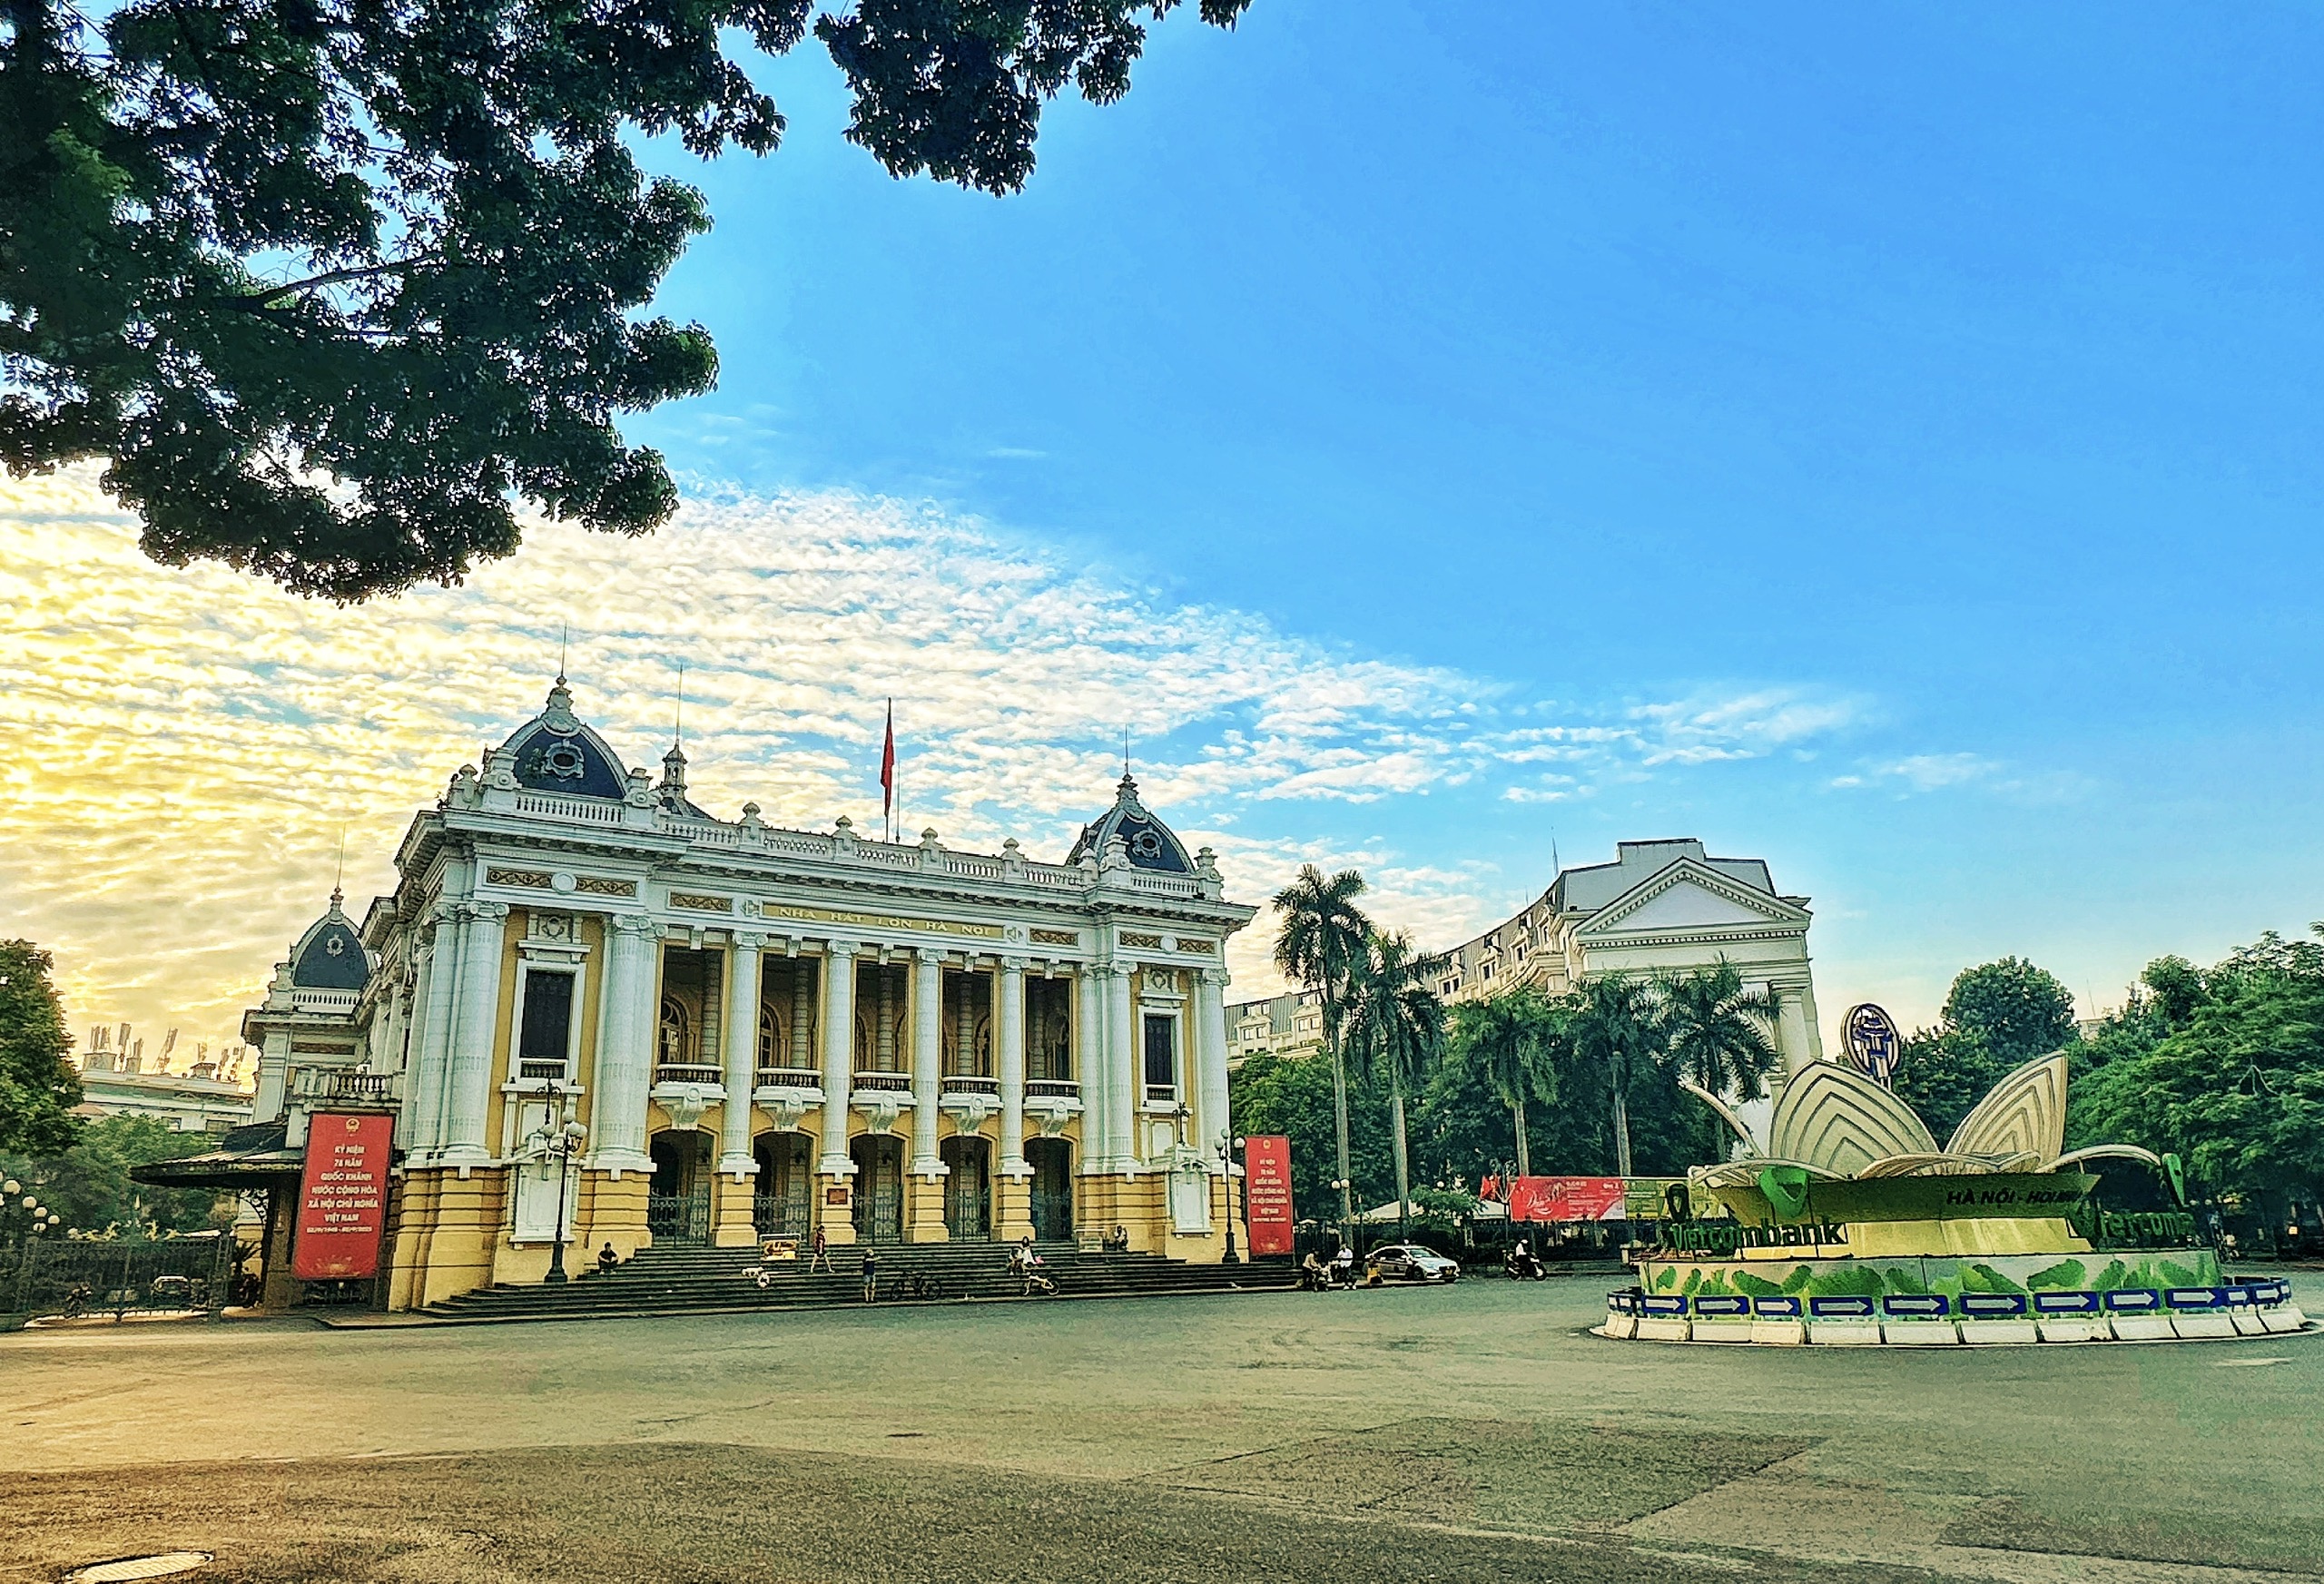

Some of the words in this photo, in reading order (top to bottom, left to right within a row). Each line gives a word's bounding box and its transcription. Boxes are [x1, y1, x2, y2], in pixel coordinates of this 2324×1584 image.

[925, 920, 949, 931] HÀ
[1946, 1187, 1975, 1205] HÀ
[1980, 1186, 2016, 1208] NỘI
[1671, 1217, 1847, 1252] Vietcombank
